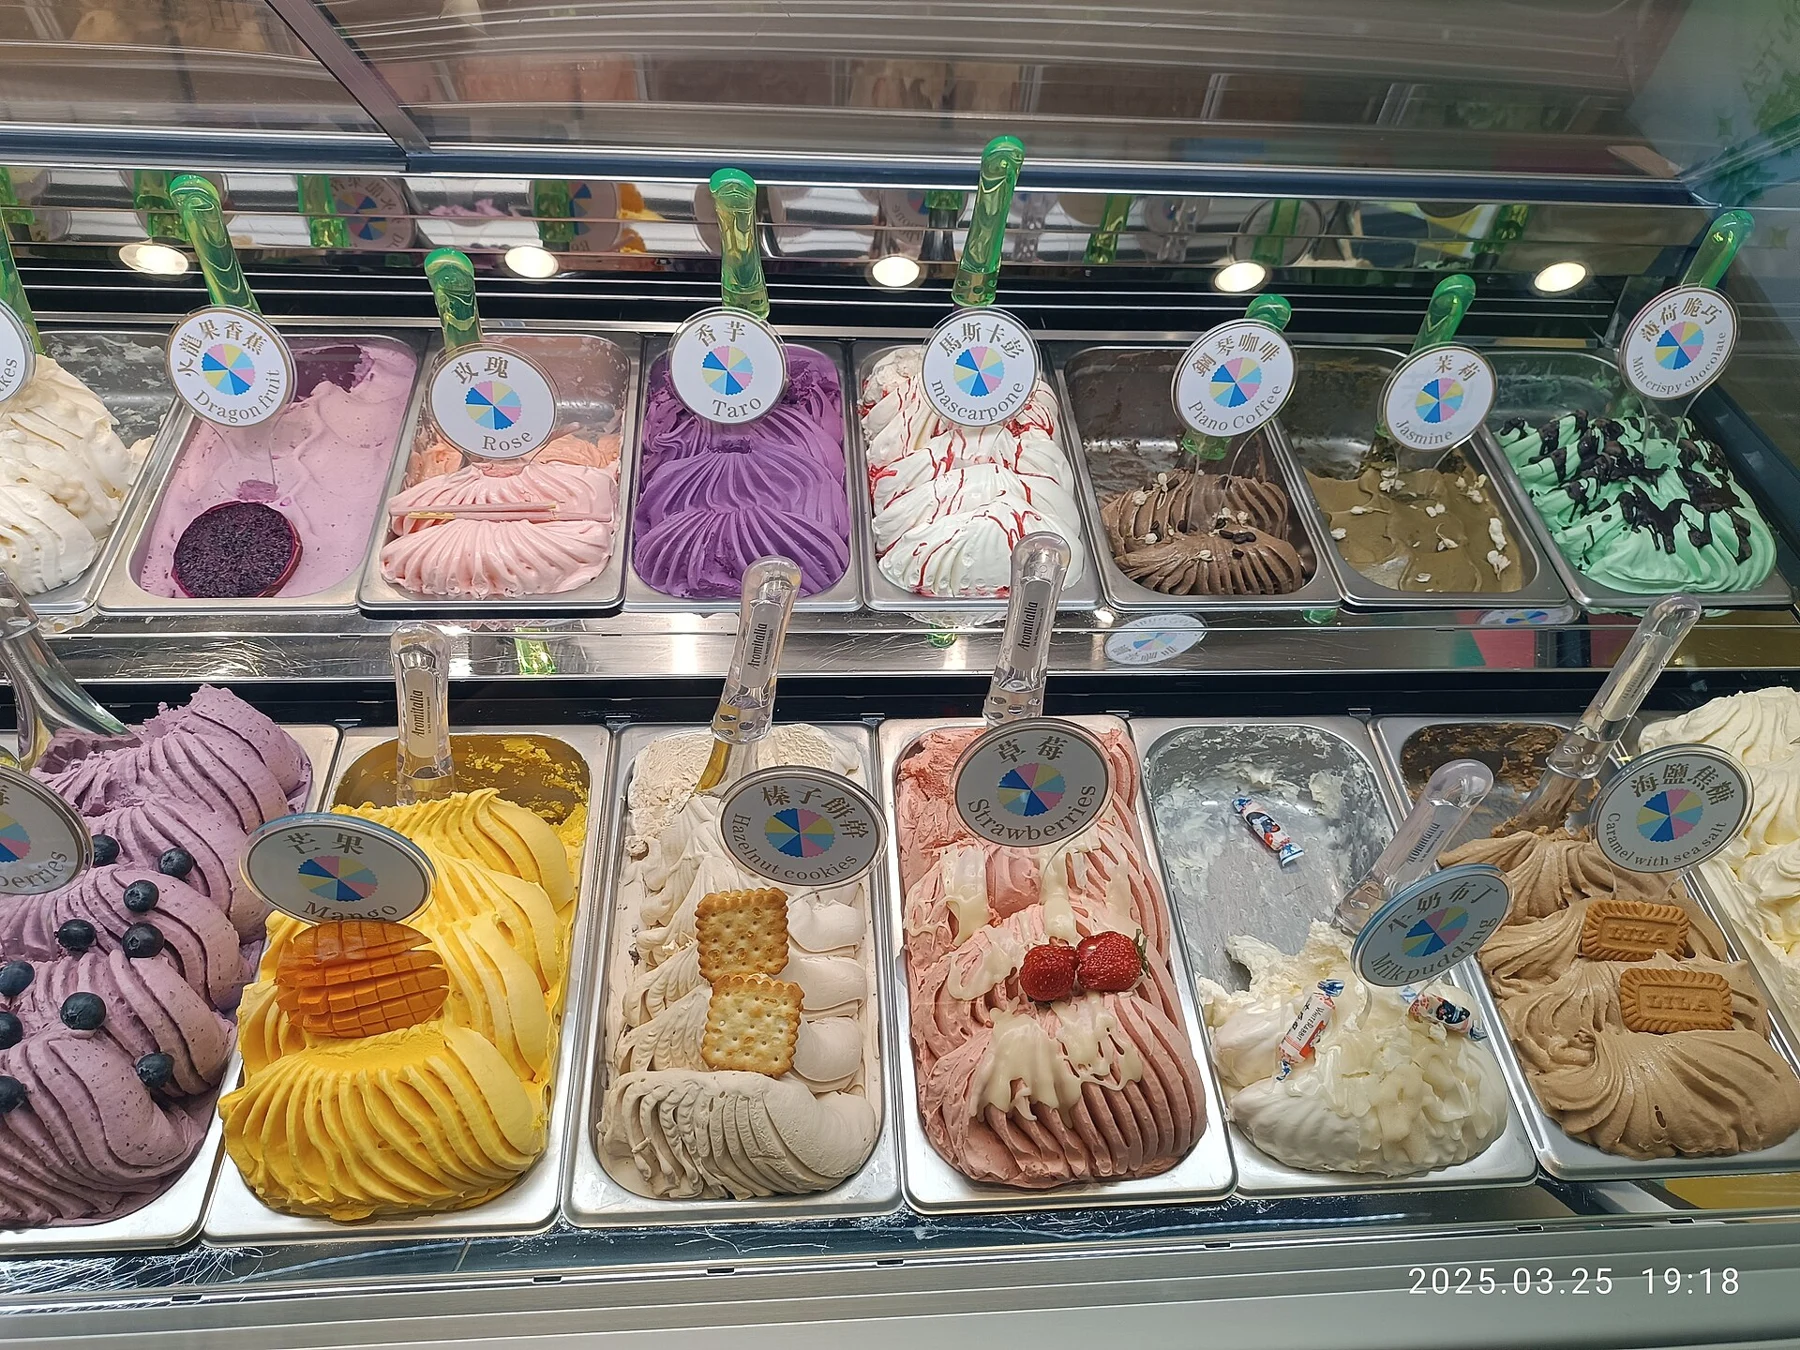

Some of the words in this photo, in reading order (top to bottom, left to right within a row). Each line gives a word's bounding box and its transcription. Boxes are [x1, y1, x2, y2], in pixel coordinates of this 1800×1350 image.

[177, 319, 268, 377] 火龍果香蕉
[695, 321, 746, 347] 香芋
[939, 322, 1025, 359] 馬斯卡彭
[1192, 332, 1280, 377] 鋼琴咖啡
[0, 358, 18, 392] kes
[451, 356, 508, 384] 玫瑰
[1434, 355, 1480, 381] 茉莉
[1633, 356, 1647, 382] Mint
[1645, 379, 1682, 395] crispy
[1684, 332, 1726, 388] chocolate
[194, 390, 261, 423] Dragon
[258, 370, 280, 410] fruit
[712, 398, 762, 418] Taro
[932, 380, 1025, 422] mascarpone
[1188, 401, 1228, 431] Piano
[1233, 385, 1282, 429] Coffee
[482, 432, 533, 451] Rose
[1396, 420, 1453, 445] Jasmine
[410, 690, 425, 738] Aromitalia
[993, 735, 1068, 764] 草莓
[761, 784, 869, 839] 榛子餅乾
[968, 785, 1096, 841] Strawberries
[283, 832, 365, 855] 芒果
[732, 813, 780, 875] Hazelnut
[784, 855, 858, 880] cookies
[1606, 812, 1635, 861] Caramel
[1634, 855, 1669, 867] with
[1673, 846, 1701, 864] sea
[1701, 822, 1727, 848] salt
[1371, 952, 1406, 981] Milk
[1404, 917, 1498, 983] pudding
